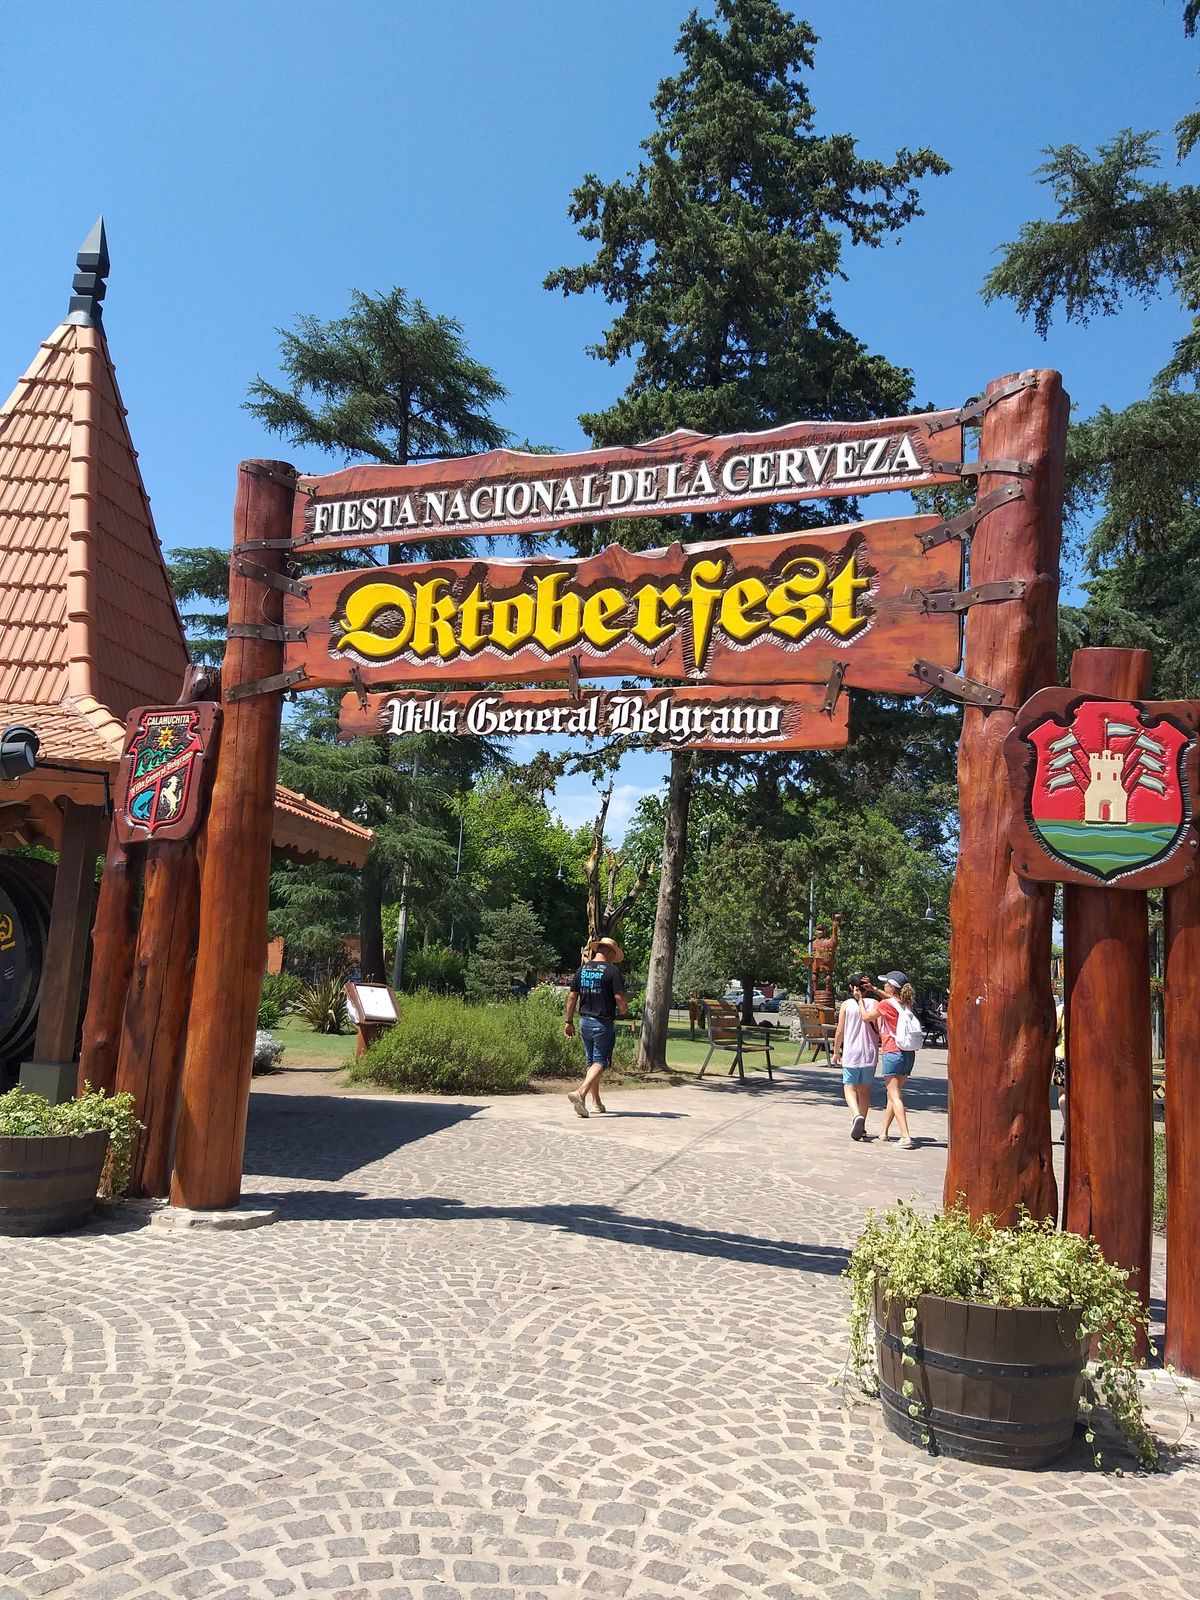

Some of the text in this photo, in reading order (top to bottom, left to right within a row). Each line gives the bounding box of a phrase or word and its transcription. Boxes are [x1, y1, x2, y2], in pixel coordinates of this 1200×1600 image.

[313, 434, 922, 535] FIESTA NACIONAL DE LA CERVEZA
[337, 554, 869, 667] Oktoberfest
[147, 715, 190, 725] CALAMUCHITA
[387, 696, 783, 741] Villa General Belgrano
[131, 751, 193, 796] Villa General Belgrano
[581, 970, 603, 979] Super
